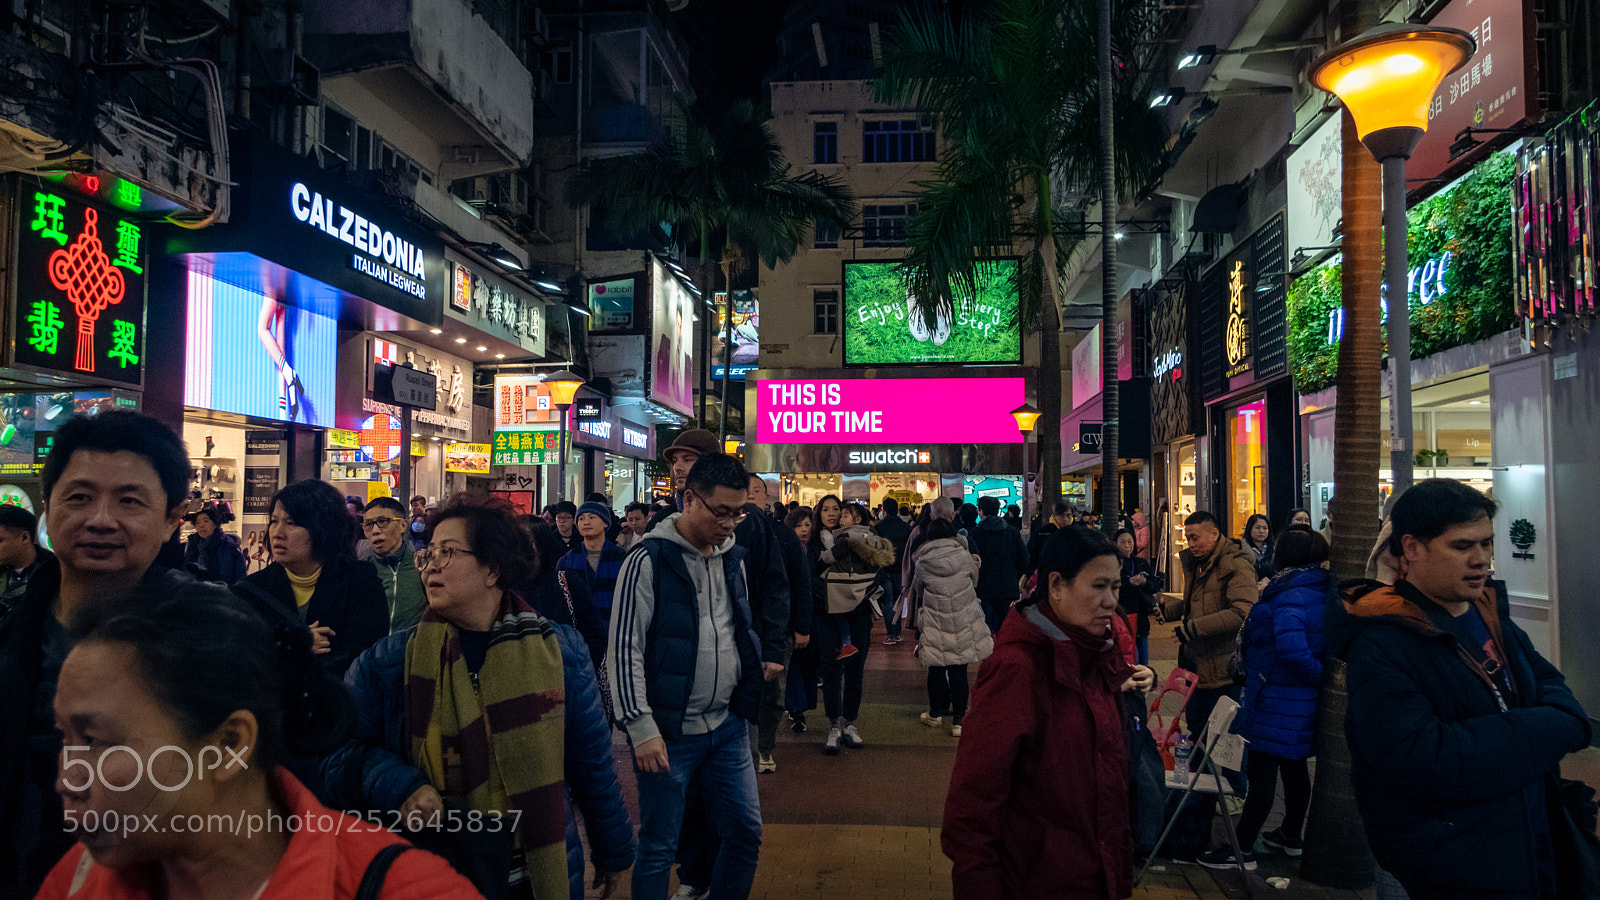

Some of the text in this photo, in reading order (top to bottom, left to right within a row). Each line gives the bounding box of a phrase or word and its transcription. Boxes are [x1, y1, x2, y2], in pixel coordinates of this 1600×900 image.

[1449, 53, 1493, 106] 沙田馬場
[291, 182, 426, 281] CALZEDONIA
[353, 254, 388, 283] ITALIAN
[388, 270, 426, 300] LEGWEAR
[858, 302, 904, 326] Enjoy
[27, 299, 140, 369] 翡 翠
[768, 383, 841, 406] THIS IS
[768, 411, 883, 433] YOUR TIME
[1466, 437, 1480, 448] Lip
[849, 448, 918, 465] swatch
